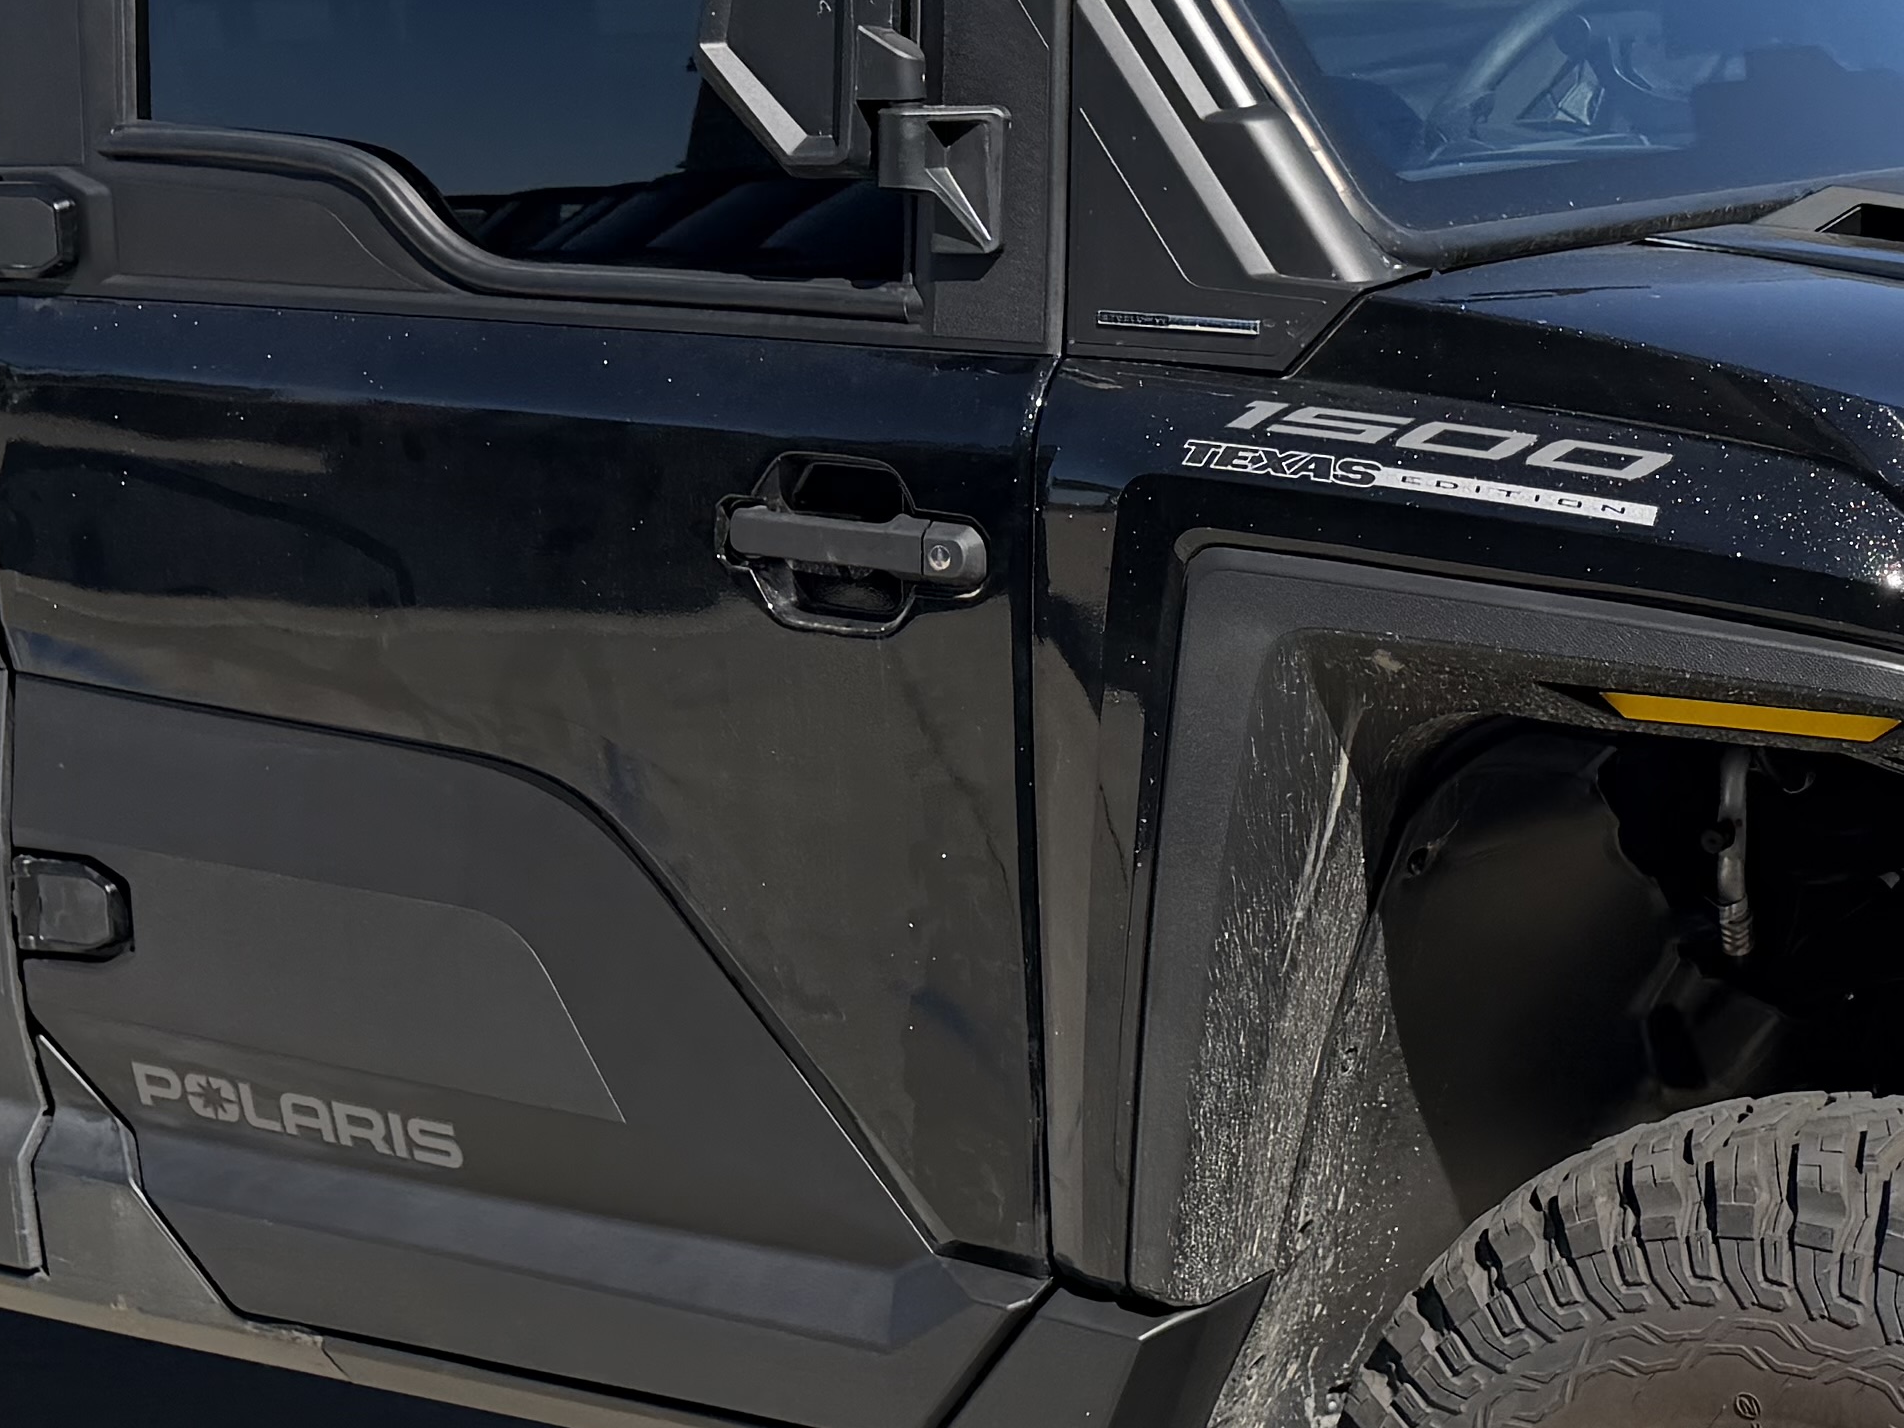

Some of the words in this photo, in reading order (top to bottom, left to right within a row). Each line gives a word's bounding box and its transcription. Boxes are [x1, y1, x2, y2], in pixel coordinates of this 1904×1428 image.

[1181, 439, 1386, 488] TEXAS
[1398, 474, 1628, 516] EDITION
[1225, 400, 1674, 481] 1500
[130, 1060, 465, 1169] POLARIS
